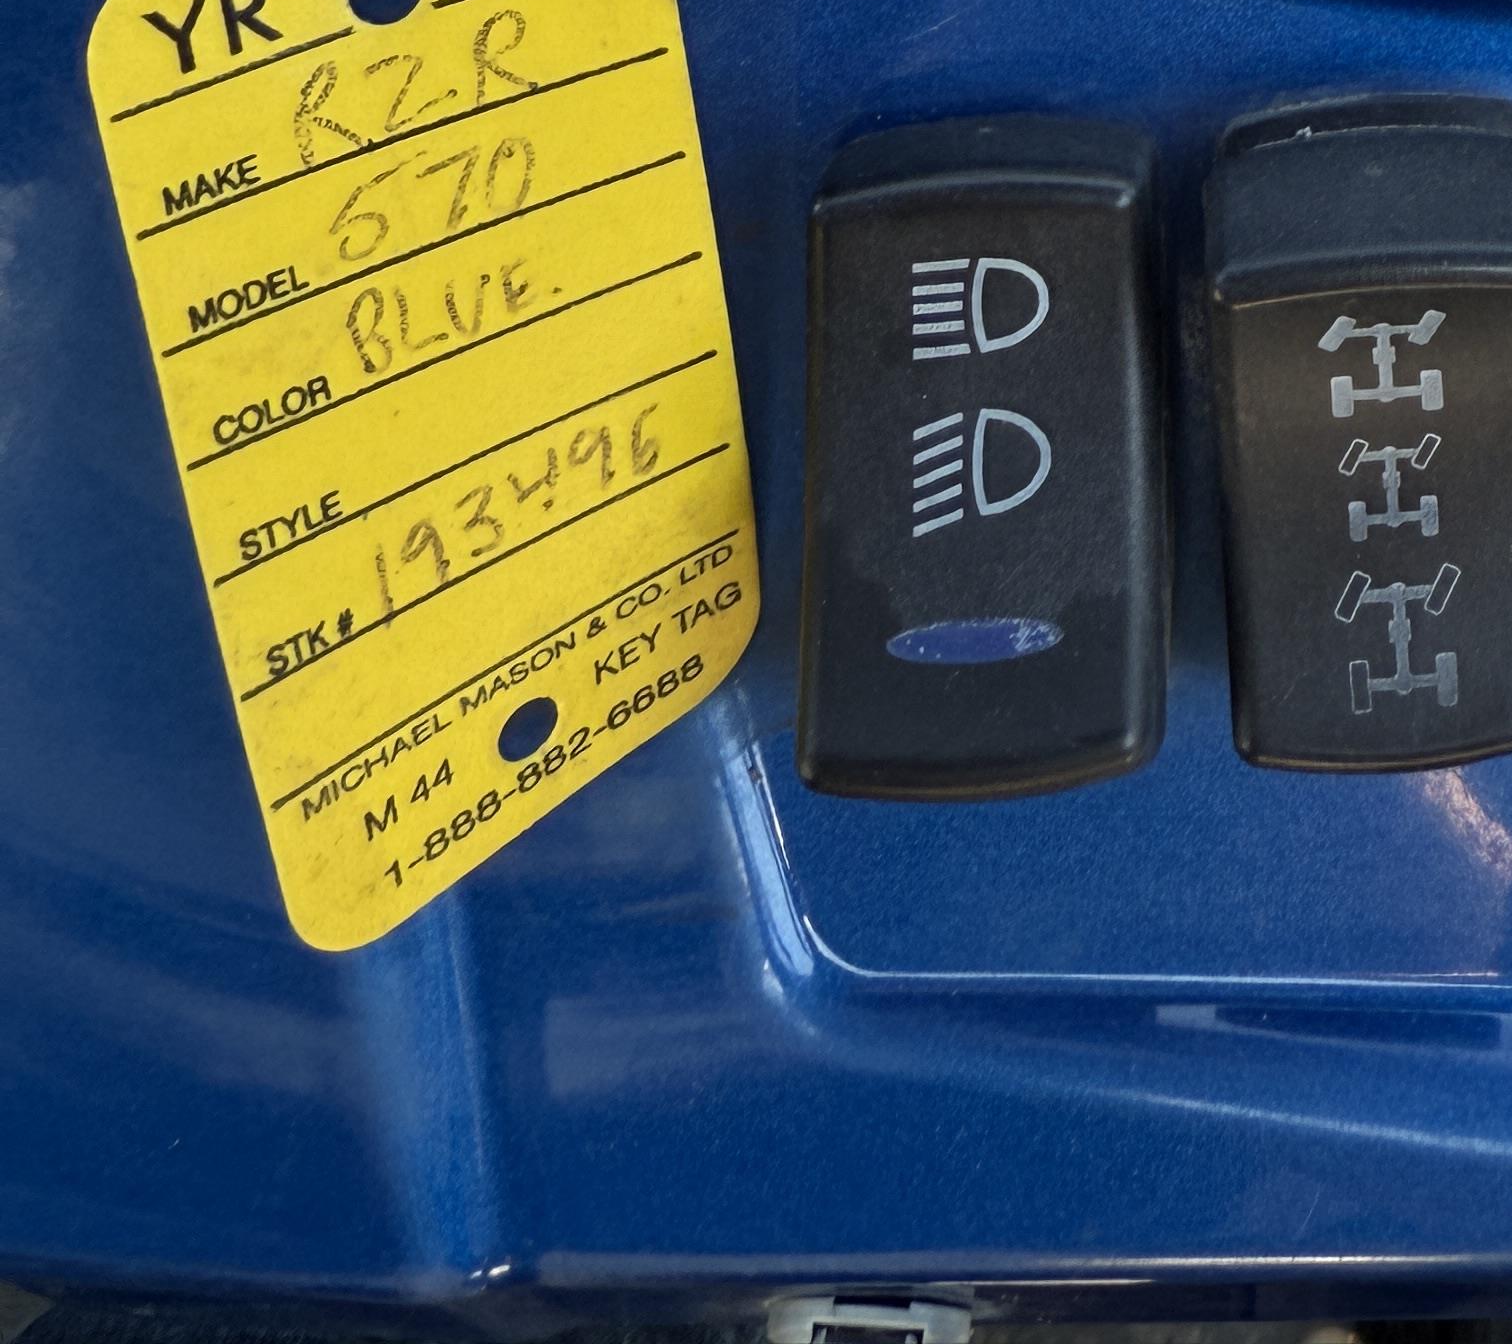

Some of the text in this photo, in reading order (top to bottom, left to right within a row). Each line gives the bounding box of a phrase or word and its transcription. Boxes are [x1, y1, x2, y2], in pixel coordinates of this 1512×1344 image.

[293, 9, 540, 168] RZR
[162, 154, 262, 217] MAKE
[329, 135, 536, 261] 570
[187, 265, 310, 332] MODEL
[213, 376, 332, 445] COLOR
[239, 490, 345, 562] STYLE
[301, 544, 734, 821] MICHAEL MASON & CO. LTD
[363, 580, 744, 842] M 44 KEY TAG
[383, 653, 705, 889] 1-888-882-6688
